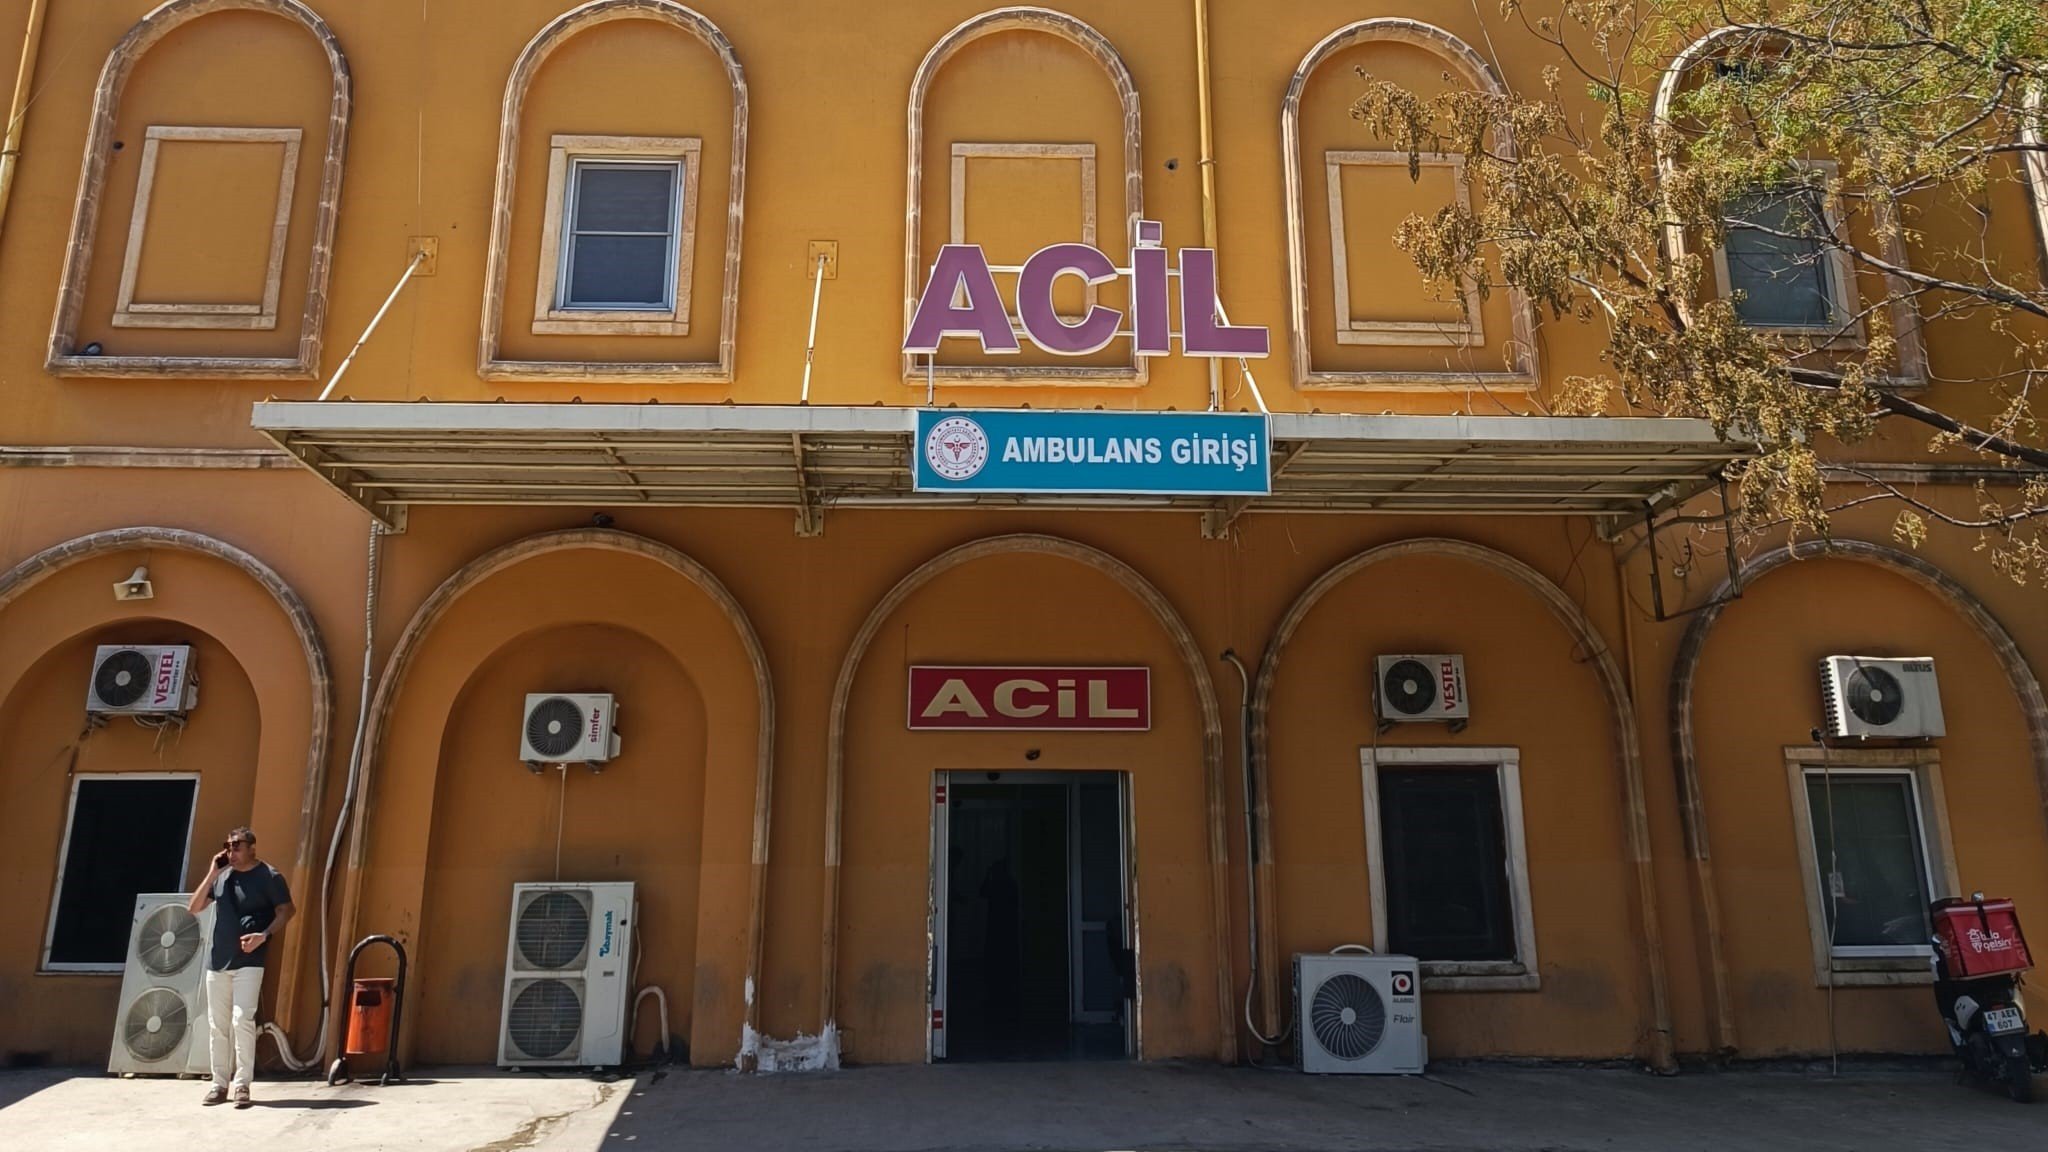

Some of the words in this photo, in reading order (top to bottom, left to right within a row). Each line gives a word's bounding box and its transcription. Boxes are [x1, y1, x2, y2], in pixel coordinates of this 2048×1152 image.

[902, 219, 1270, 358] ACİL
[1002, 436, 1162, 465] AMBULANS
[1171, 432, 1258, 472] GİRİŞİ
[154, 650, 175, 704] VESTEL
[1441, 658, 1456, 710] VESTEL
[588, 707, 600, 743] simfer
[1393, 1014, 1415, 1023] Flair
